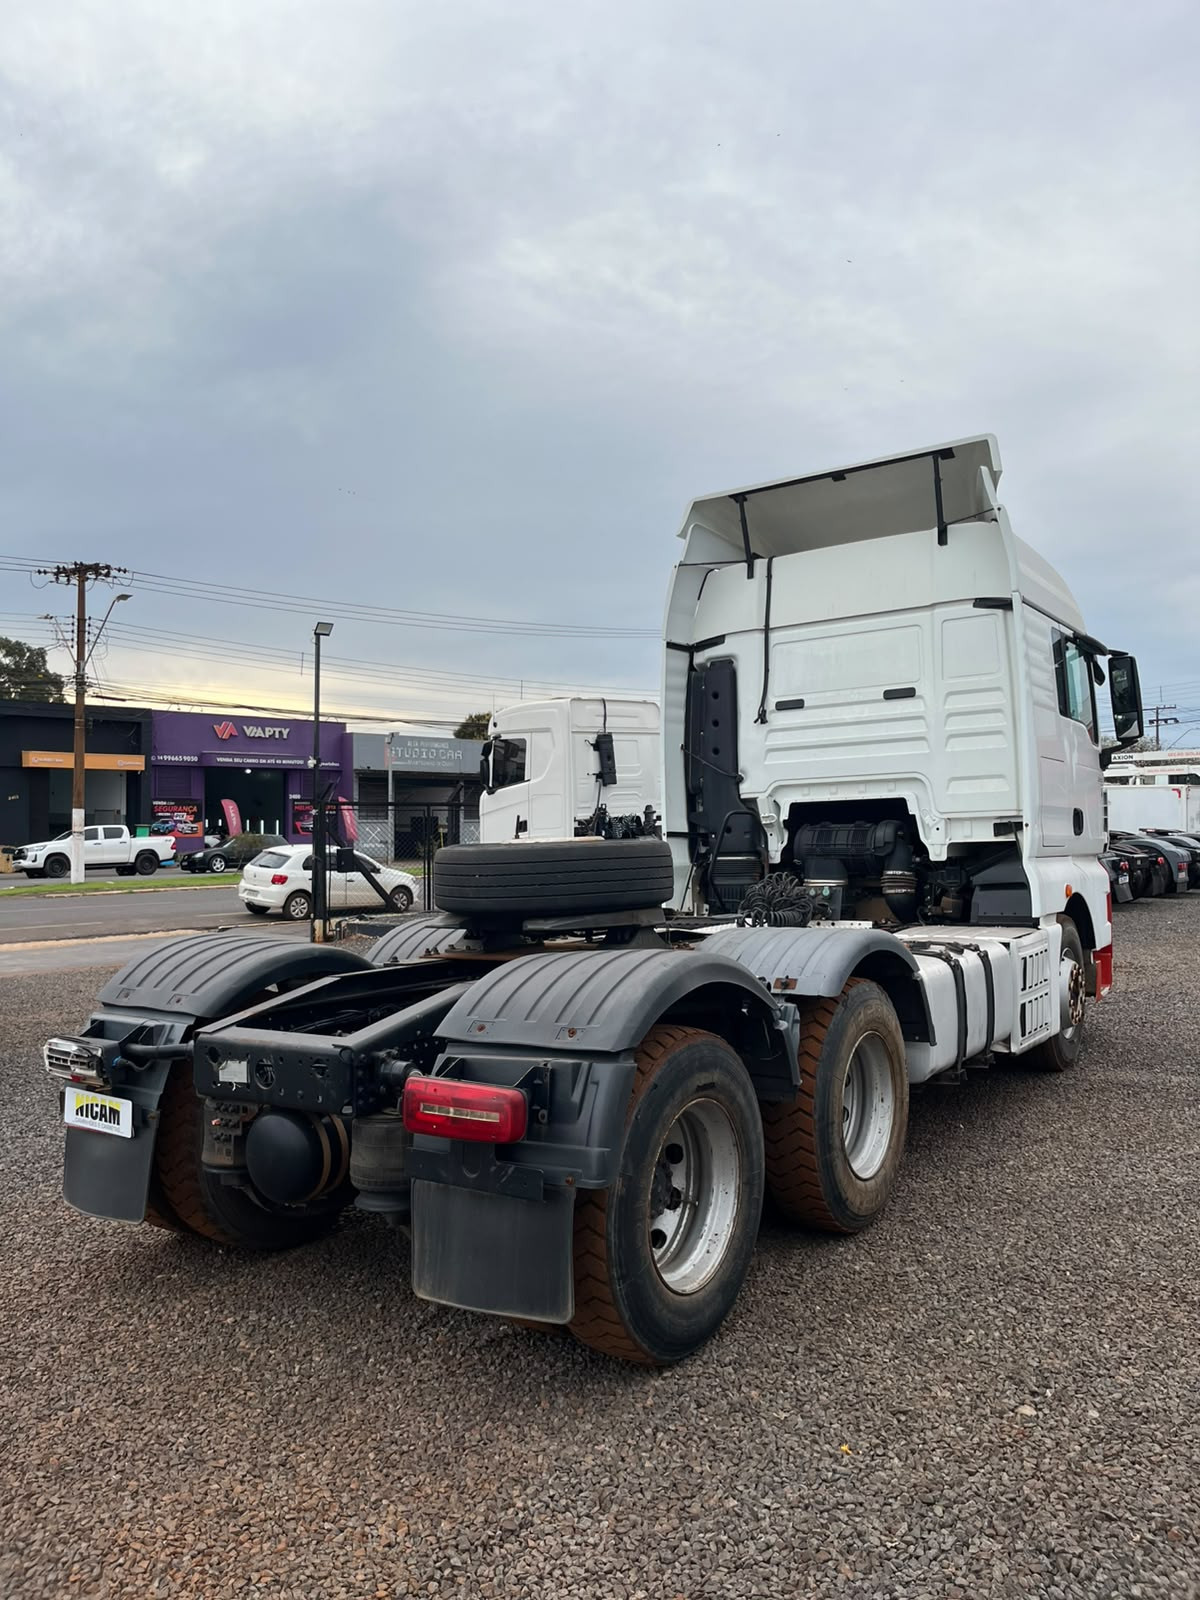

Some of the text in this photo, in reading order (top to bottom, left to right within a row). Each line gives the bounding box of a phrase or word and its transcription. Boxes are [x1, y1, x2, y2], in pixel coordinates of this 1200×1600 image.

[243, 725, 290, 739] VAPTY
[440, 750, 463, 760] CAR
[153, 805, 198, 814] SEGURANÇA
[75, 1093, 120, 1126] NICAM
